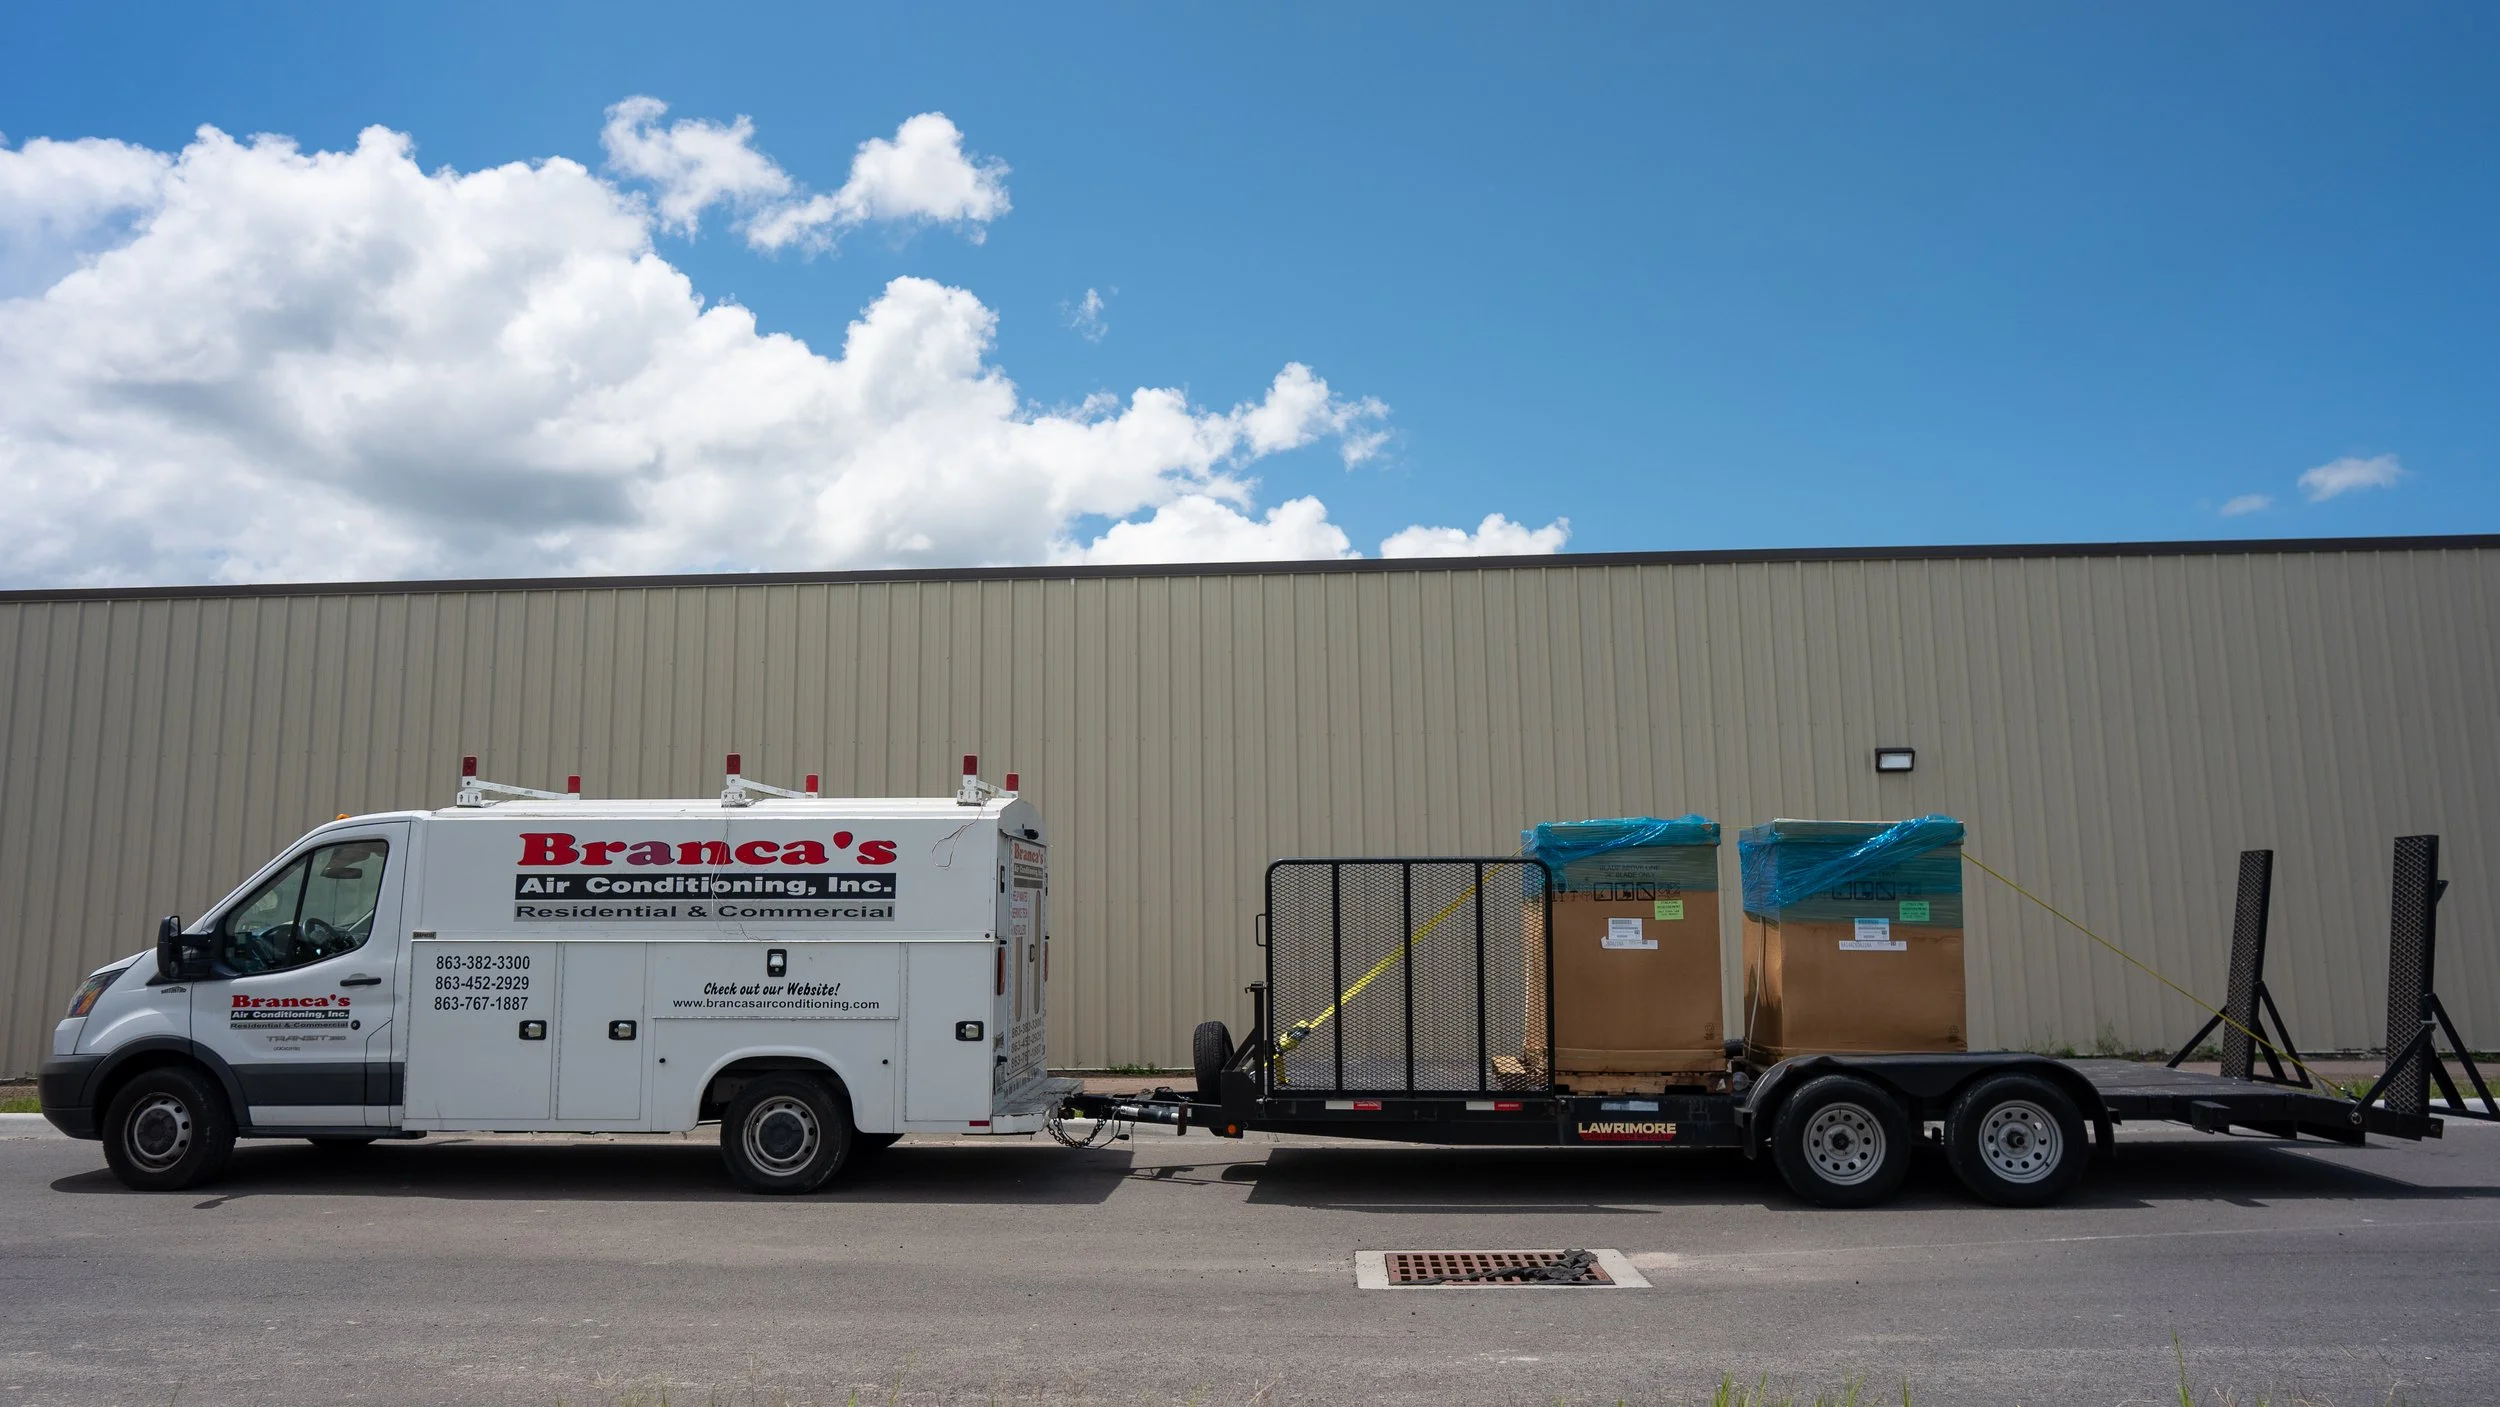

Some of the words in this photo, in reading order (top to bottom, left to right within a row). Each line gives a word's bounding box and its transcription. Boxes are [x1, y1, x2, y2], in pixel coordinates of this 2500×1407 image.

[519, 831, 897, 866] Branca's
[1014, 842, 1043, 864] Branca's
[519, 877, 570, 894] Air
[585, 876, 817, 897] Conditioning,
[828, 876, 892, 894] Inc.
[516, 904, 677, 918] Residential
[688, 904, 708, 918] &
[718, 904, 893, 919] Commercial
[436, 955, 530, 970] 863-382-3300
[435, 976, 529, 990] 863-452-2929
[703, 982, 737, 995] Check
[740, 984, 760, 995] out
[763, 985, 783, 995] our
[787, 982, 841, 996] Website!
[231, 994, 351, 1008] Branca's
[434, 996, 529, 1010] 863-767-1887
[673, 998, 880, 1011] www.brancasairconditioning.com
[232, 1011, 249, 1019] Air
[253, 1010, 325, 1019] Conditioning,
[328, 1010, 349, 1018] Inc.
[283, 1021, 291, 1029] &
[293, 1020, 348, 1028] Commercial
[266, 1034, 327, 1042] TRANSIT
[1578, 1122, 1677, 1134] LAWRIMORE
